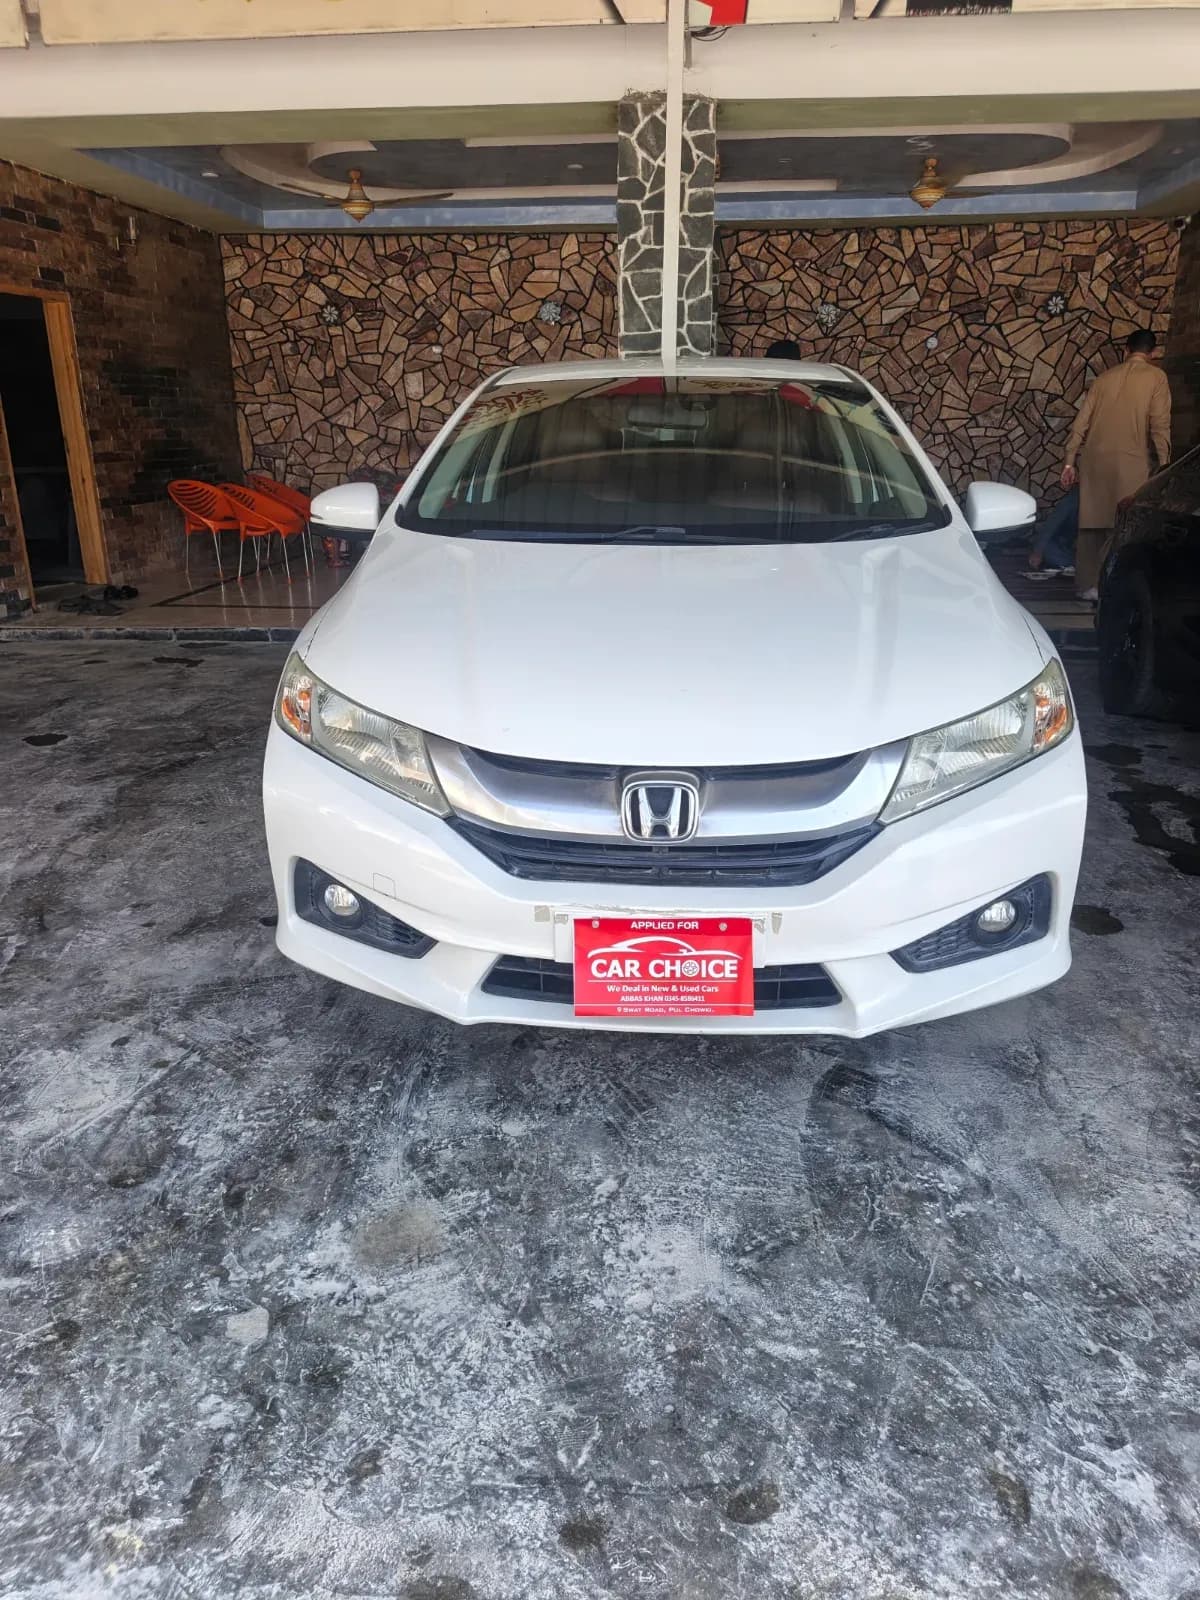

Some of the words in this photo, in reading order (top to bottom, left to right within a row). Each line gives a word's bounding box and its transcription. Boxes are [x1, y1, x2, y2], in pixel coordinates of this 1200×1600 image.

[630, 920, 675, 930] APPLIED
[677, 921, 699, 930] FOR
[590, 959, 642, 979] CAR
[648, 959, 738, 979] CHOICE
